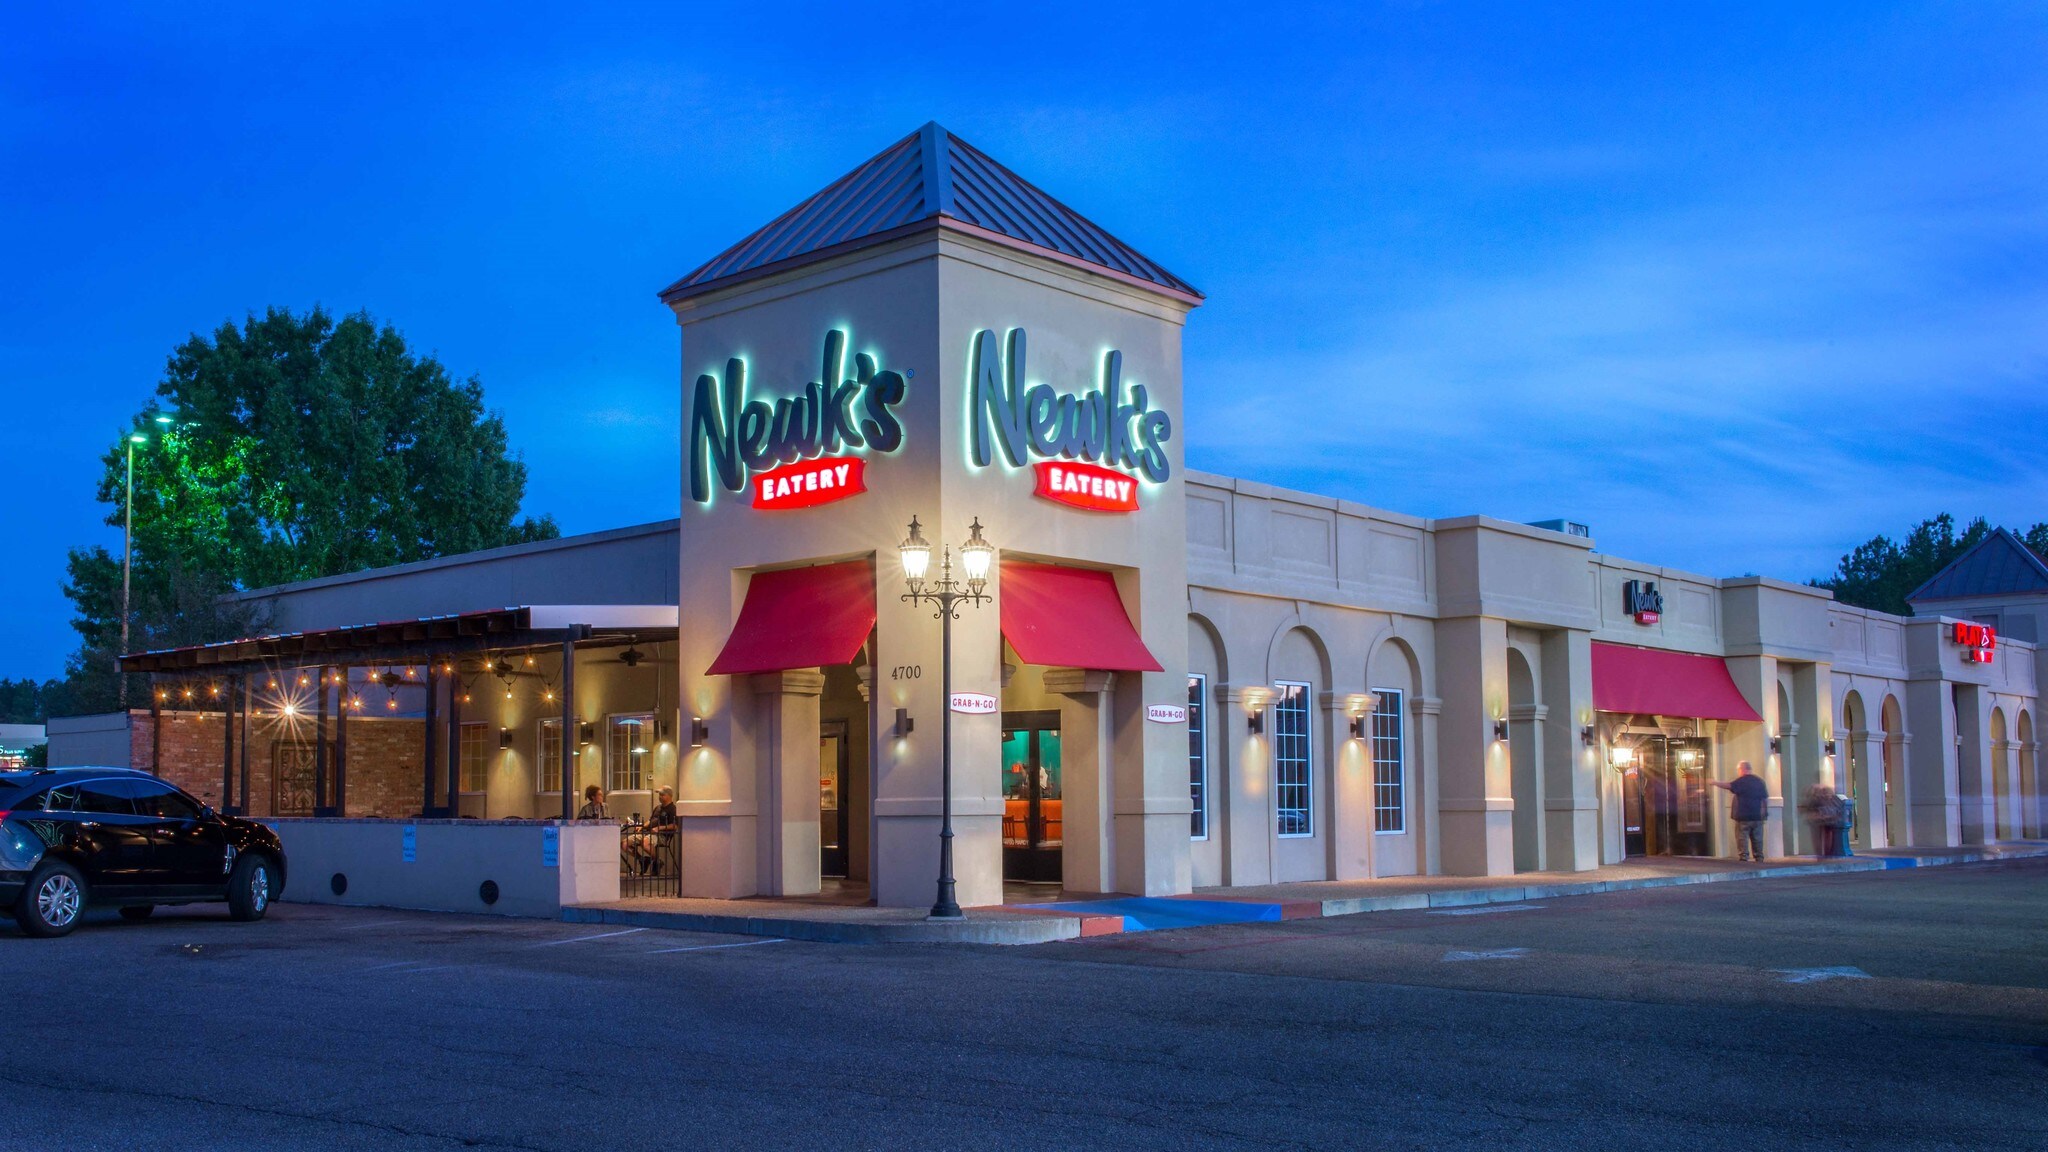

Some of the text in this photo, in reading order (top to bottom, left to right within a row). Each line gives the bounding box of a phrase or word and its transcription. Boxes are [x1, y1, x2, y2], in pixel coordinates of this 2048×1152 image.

[691, 329, 905, 502] Newk's
[970, 327, 1171, 484] Newk's
[762, 464, 850, 501] EATERY
[1050, 467, 1131, 502] EATERY
[891, 665, 921, 680] 4700
[952, 698, 994, 709] GRAB-N-GO
[1150, 709, 1183, 719] GRAB-N-GO
